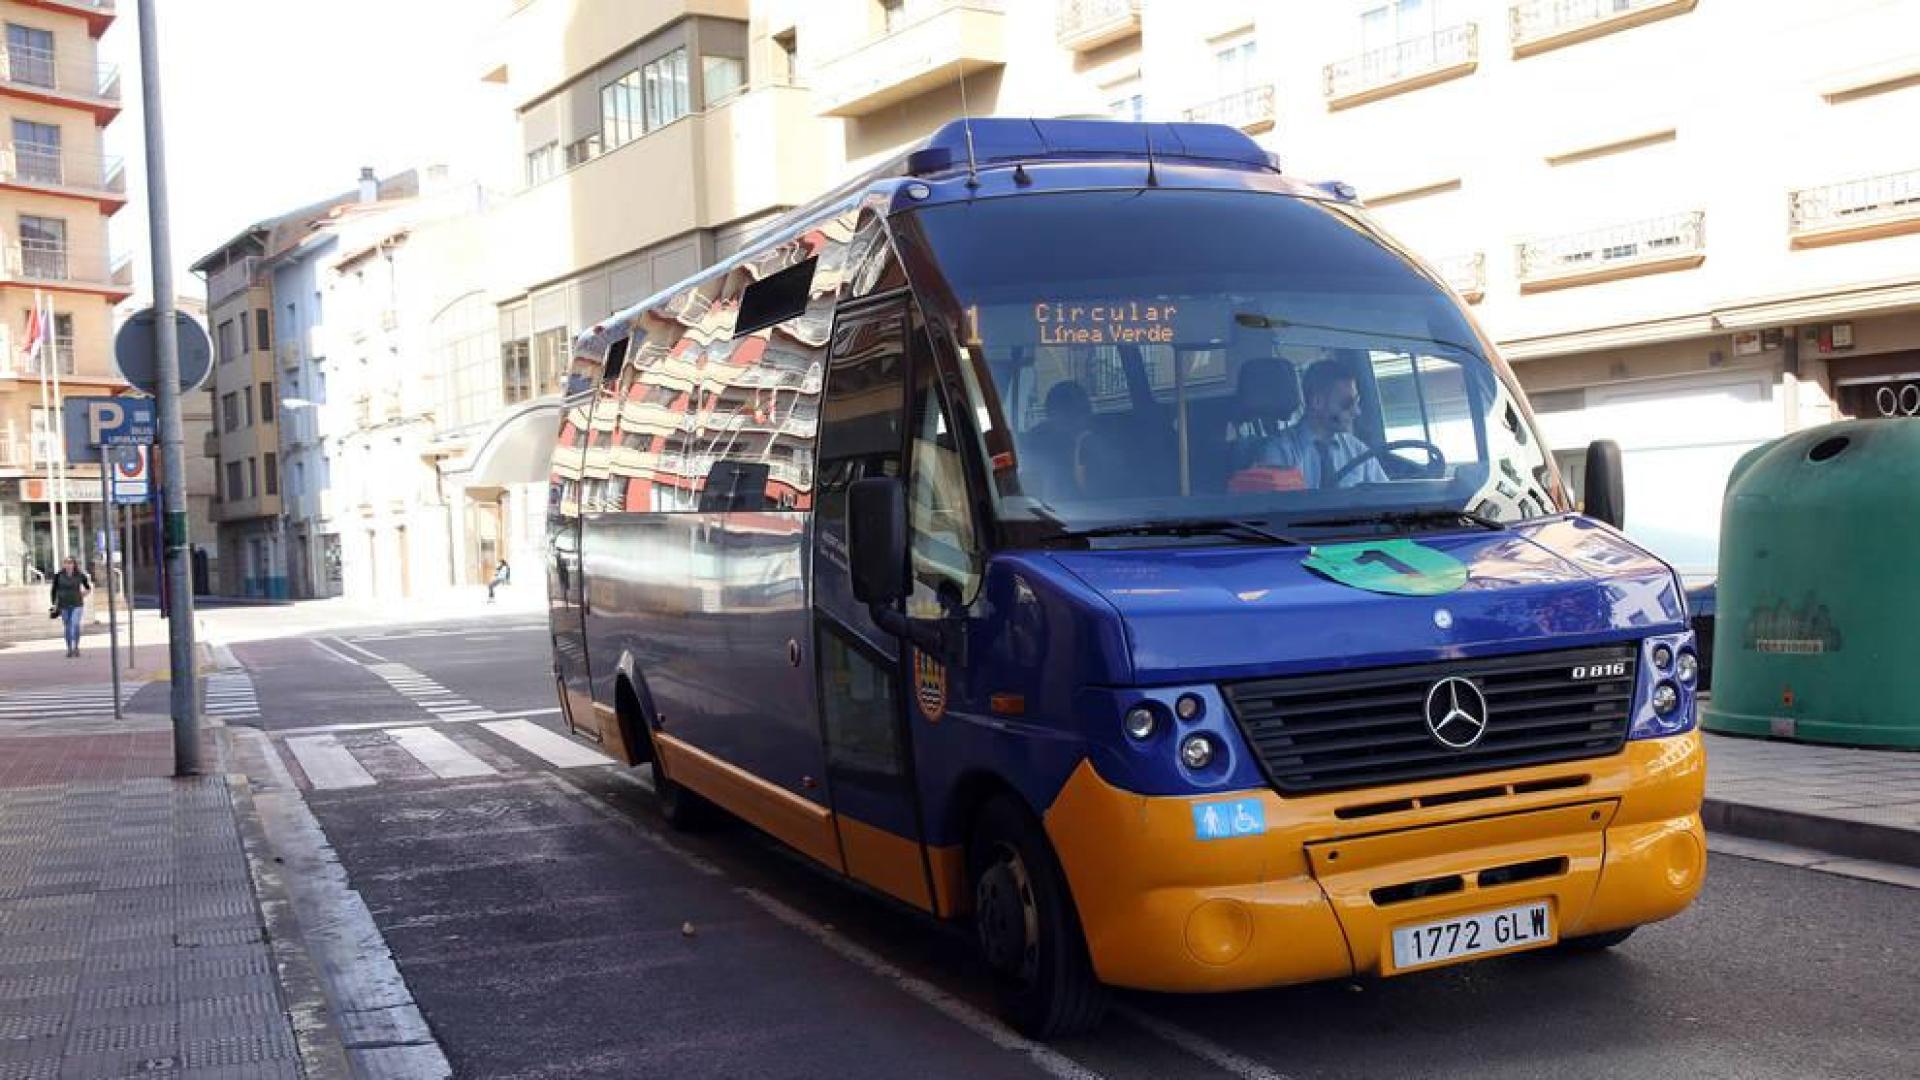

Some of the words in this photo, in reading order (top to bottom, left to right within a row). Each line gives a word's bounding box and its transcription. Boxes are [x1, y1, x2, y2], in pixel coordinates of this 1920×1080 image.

[966, 305, 983, 344] 1
[1035, 302, 1177, 322] Circular
[1040, 324, 1102, 343] Línea
[1109, 324, 1174, 342] Verde
[89, 403, 124, 443] P
[1590, 663, 1625, 677] 816
[1413, 920, 1480, 959] 1772
[1494, 907, 1545, 943] GLW
